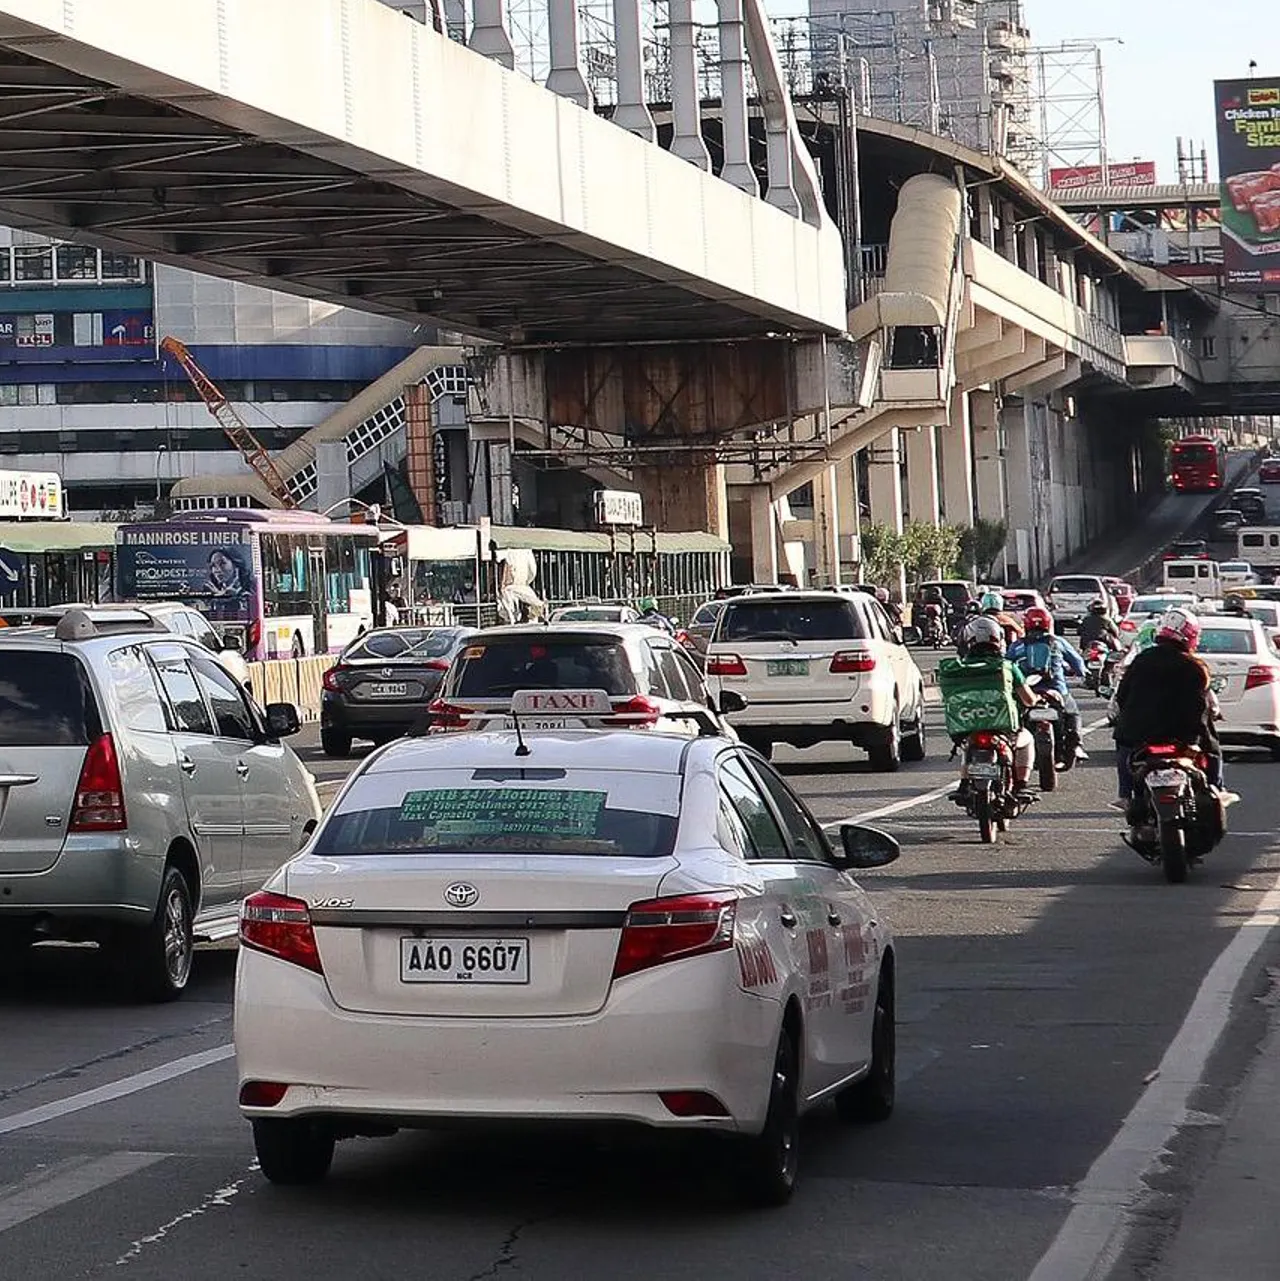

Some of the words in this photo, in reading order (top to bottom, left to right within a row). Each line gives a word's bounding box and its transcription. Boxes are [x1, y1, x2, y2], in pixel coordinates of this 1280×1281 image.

[127, 532, 198, 545] MANNROSE
[202, 532, 240, 545] LINER
[527, 695, 589, 708] TAXI
[959, 703, 998, 721] Grab
[463, 945, 522, 971] 6607
